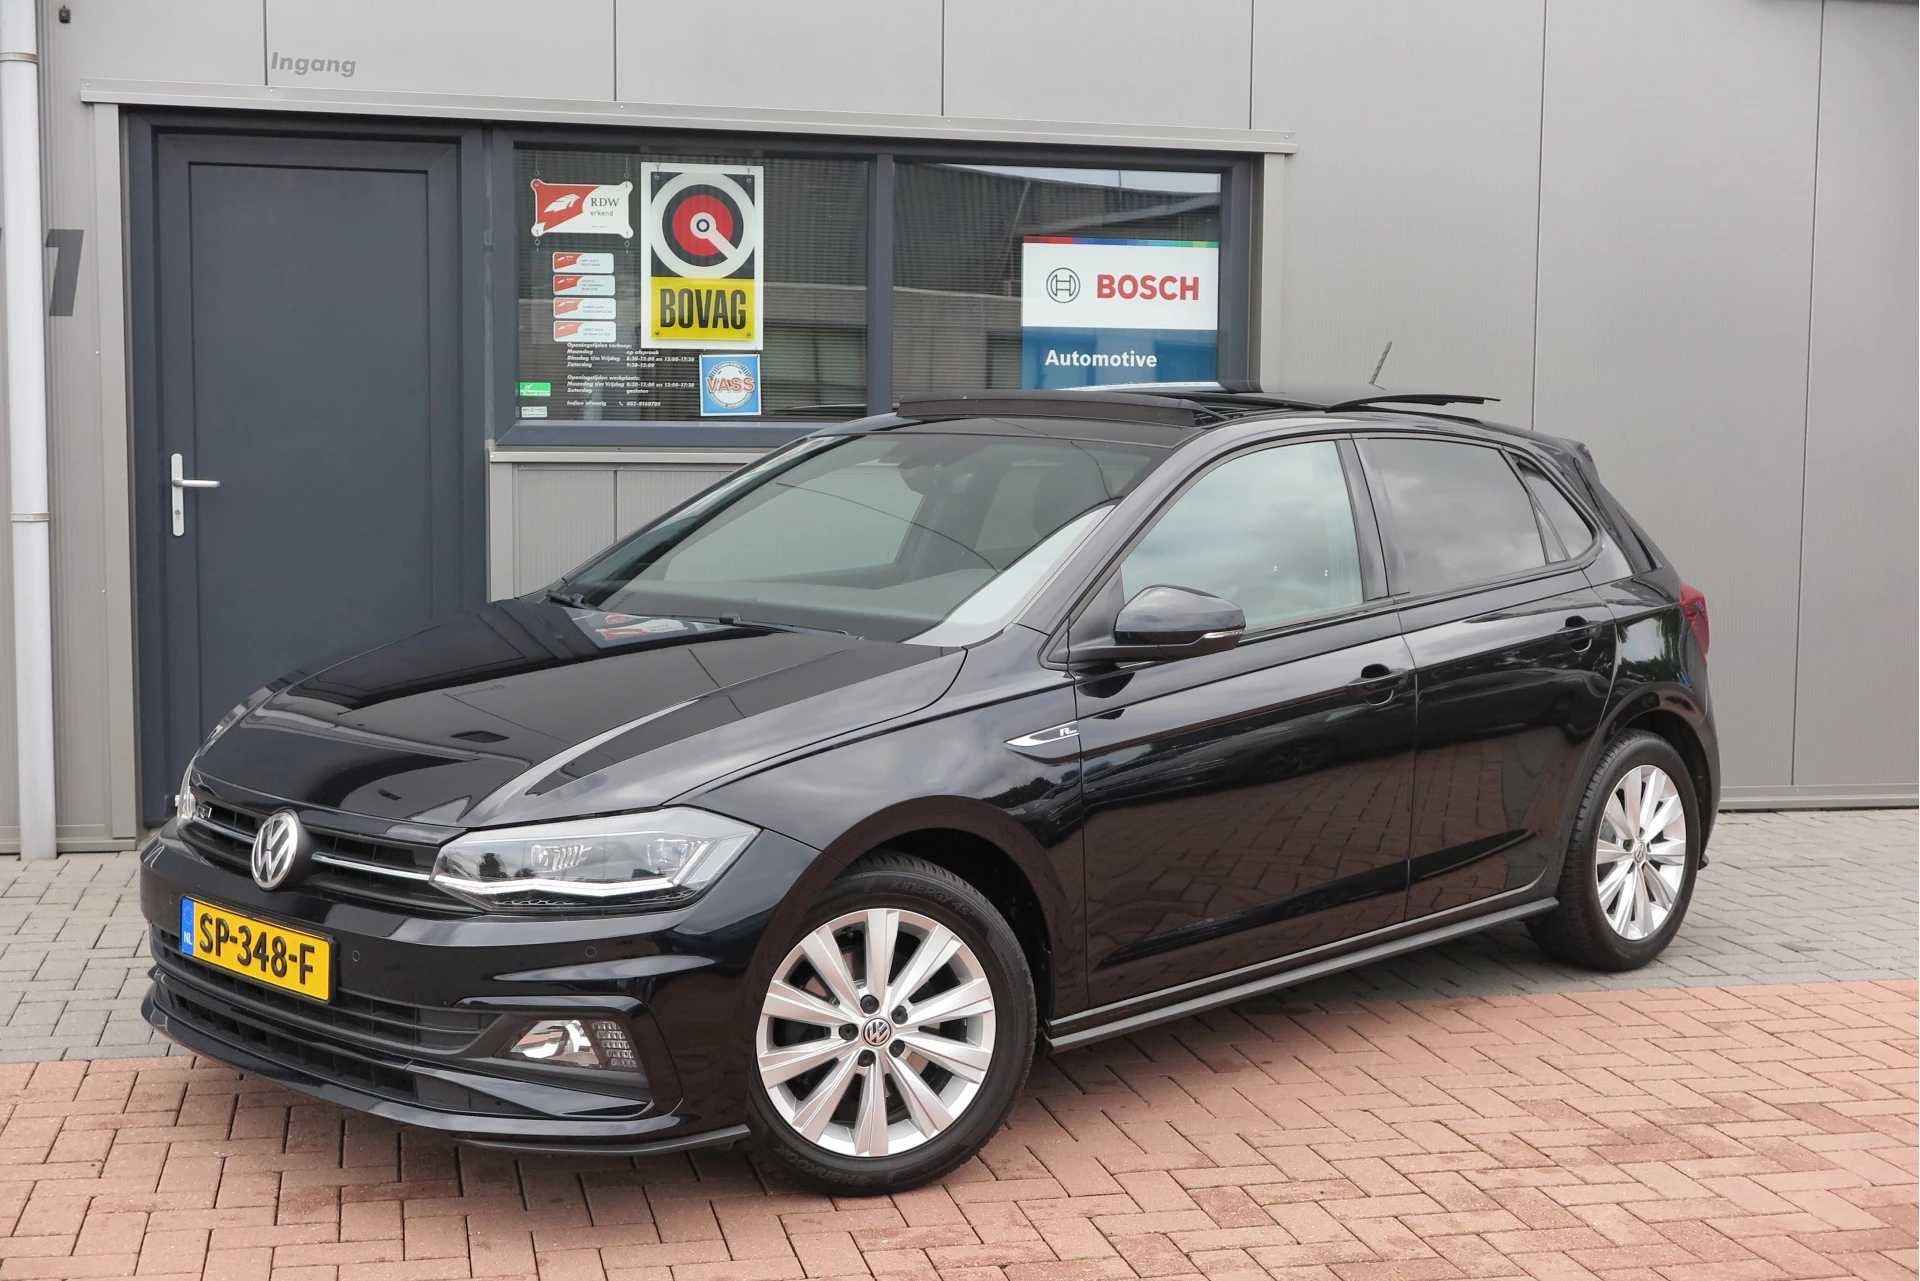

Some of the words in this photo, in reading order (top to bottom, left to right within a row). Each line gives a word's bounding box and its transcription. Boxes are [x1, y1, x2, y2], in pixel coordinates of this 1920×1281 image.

[270, 52, 357, 78] Ingang
[590, 197, 620, 207] RDW
[590, 209, 614, 217] erkend
[1096, 273, 1200, 301] BOSCH
[659, 287, 747, 330] BOVAG
[1044, 349, 1158, 368] Automotive
[706, 377, 755, 393] VASS
[183, 930, 193, 946] NL
[198, 912, 316, 986] SP-348-F
